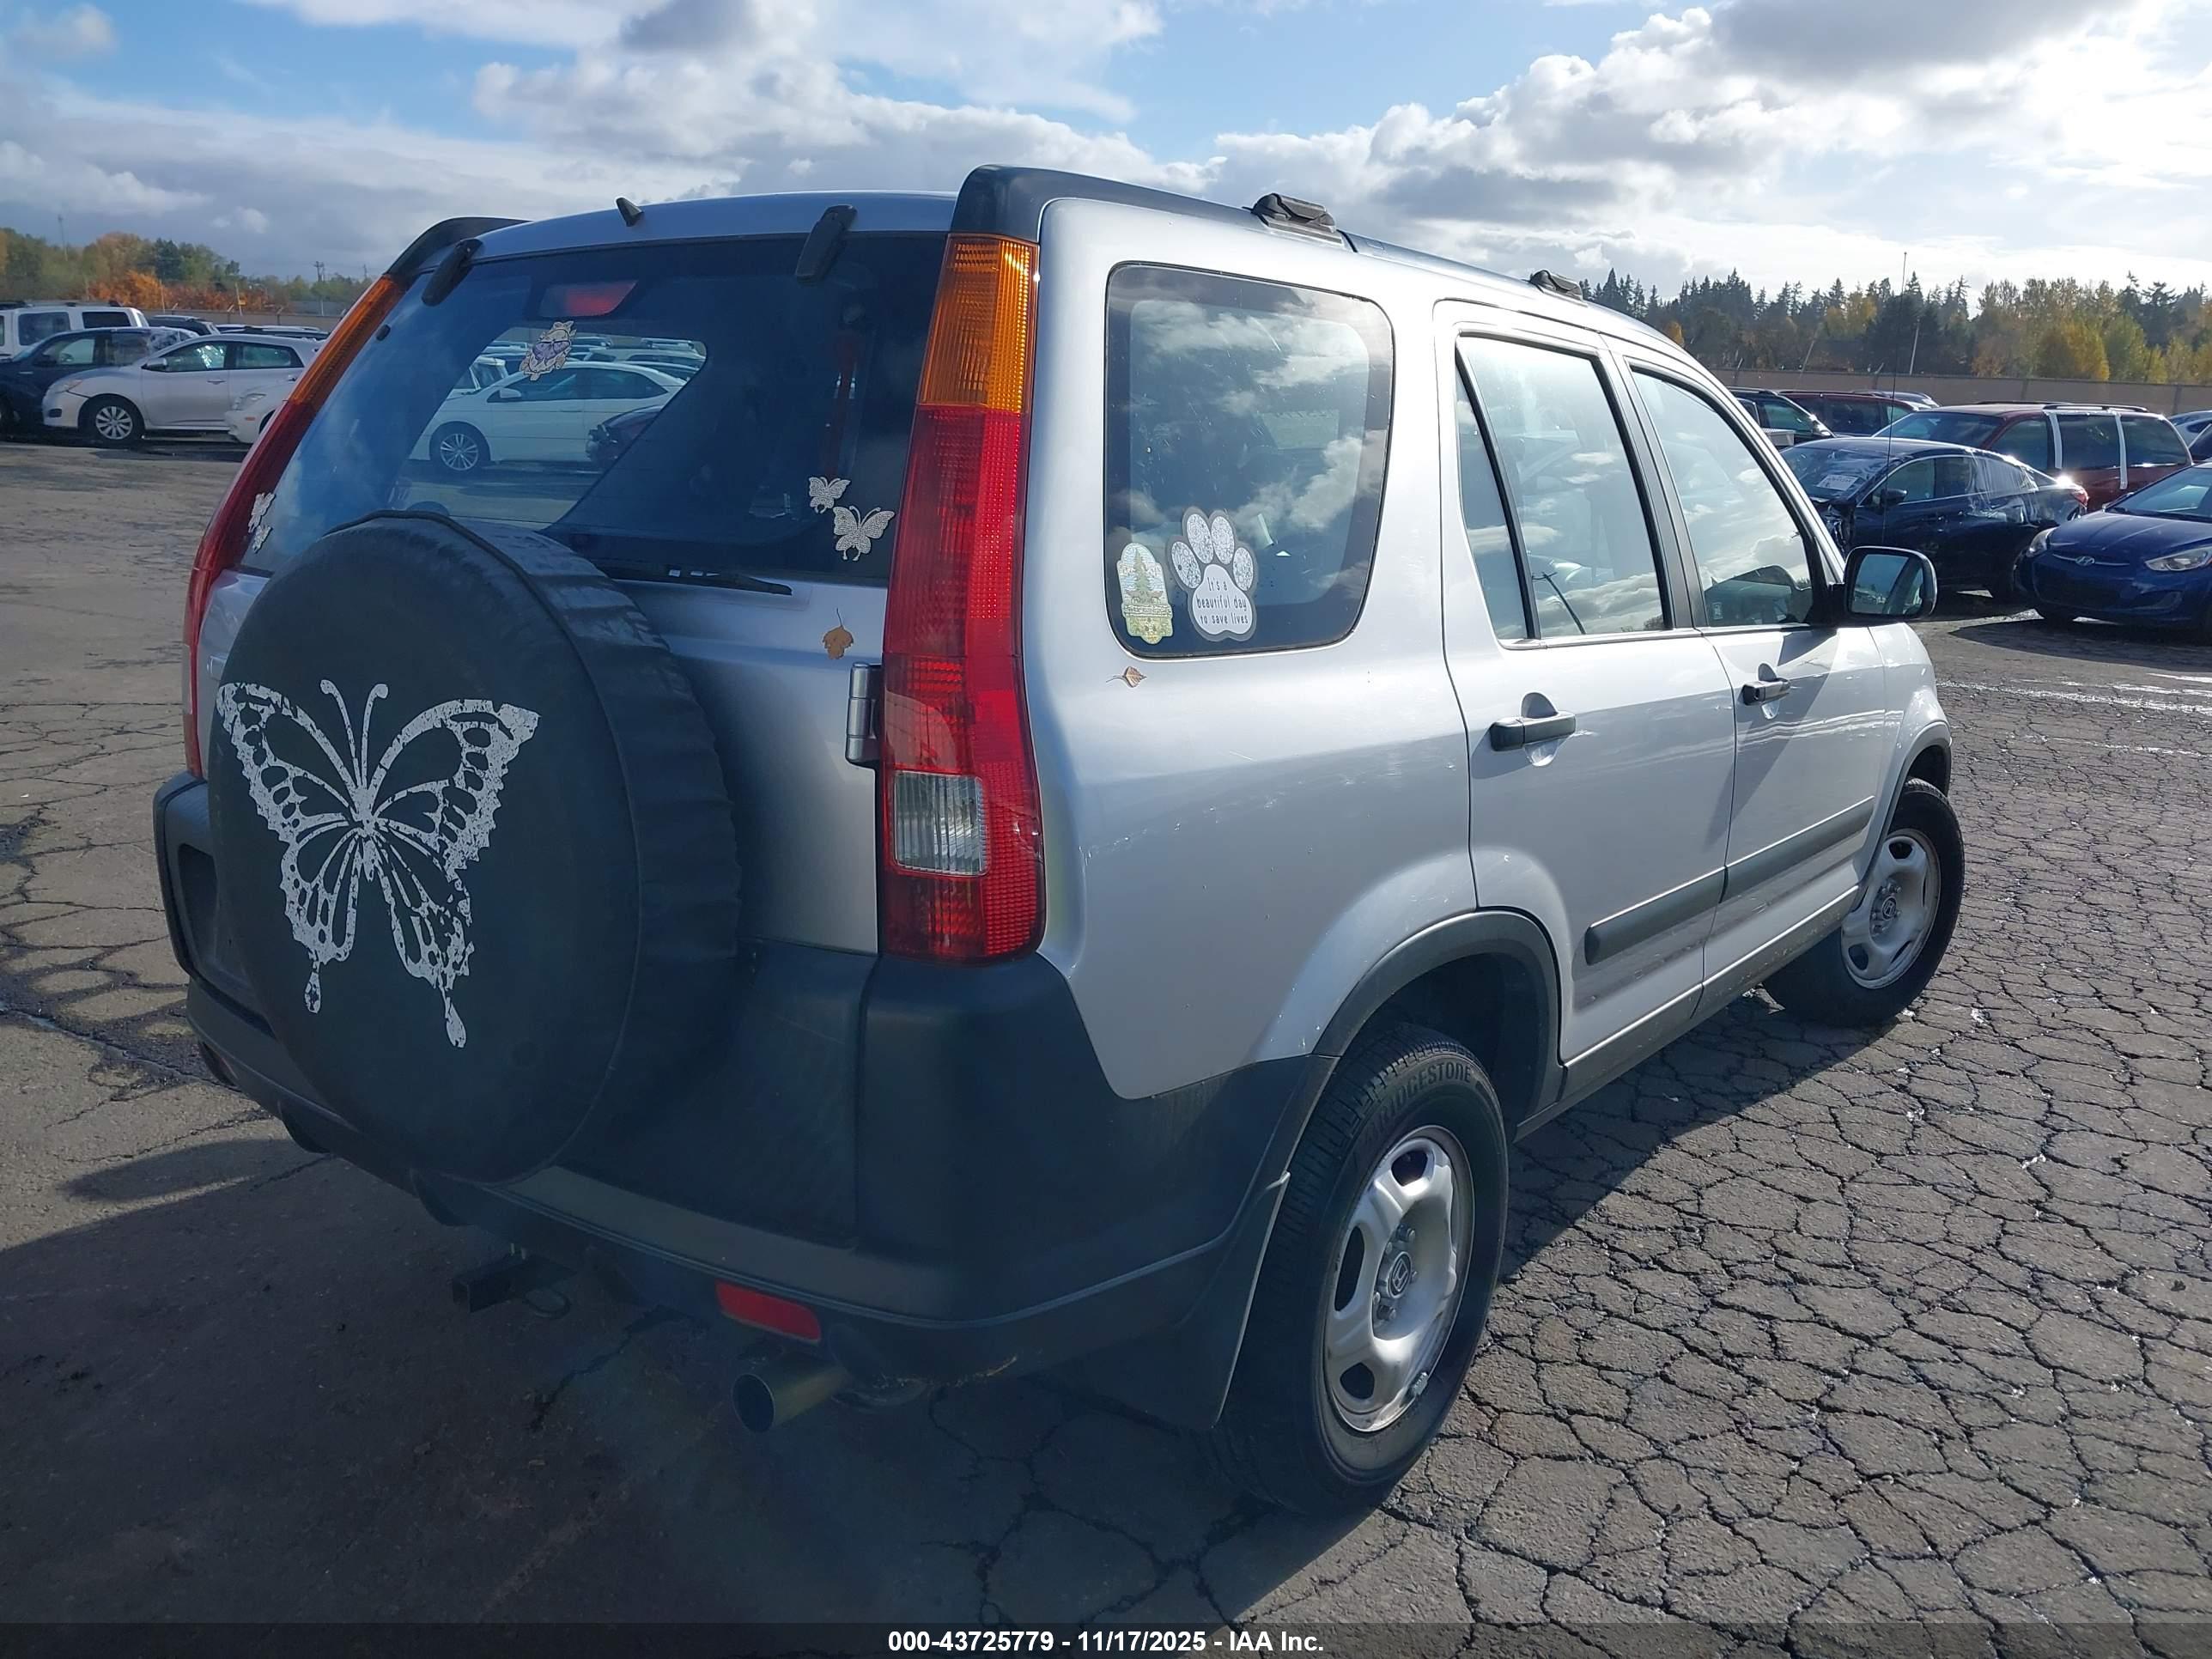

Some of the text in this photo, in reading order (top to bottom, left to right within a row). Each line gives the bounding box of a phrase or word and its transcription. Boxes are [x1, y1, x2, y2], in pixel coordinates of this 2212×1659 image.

[1206, 576, 1228, 592] It's a
[1195, 594, 1248, 612] beautiful day
[1200, 611, 1249, 625] to save lives
